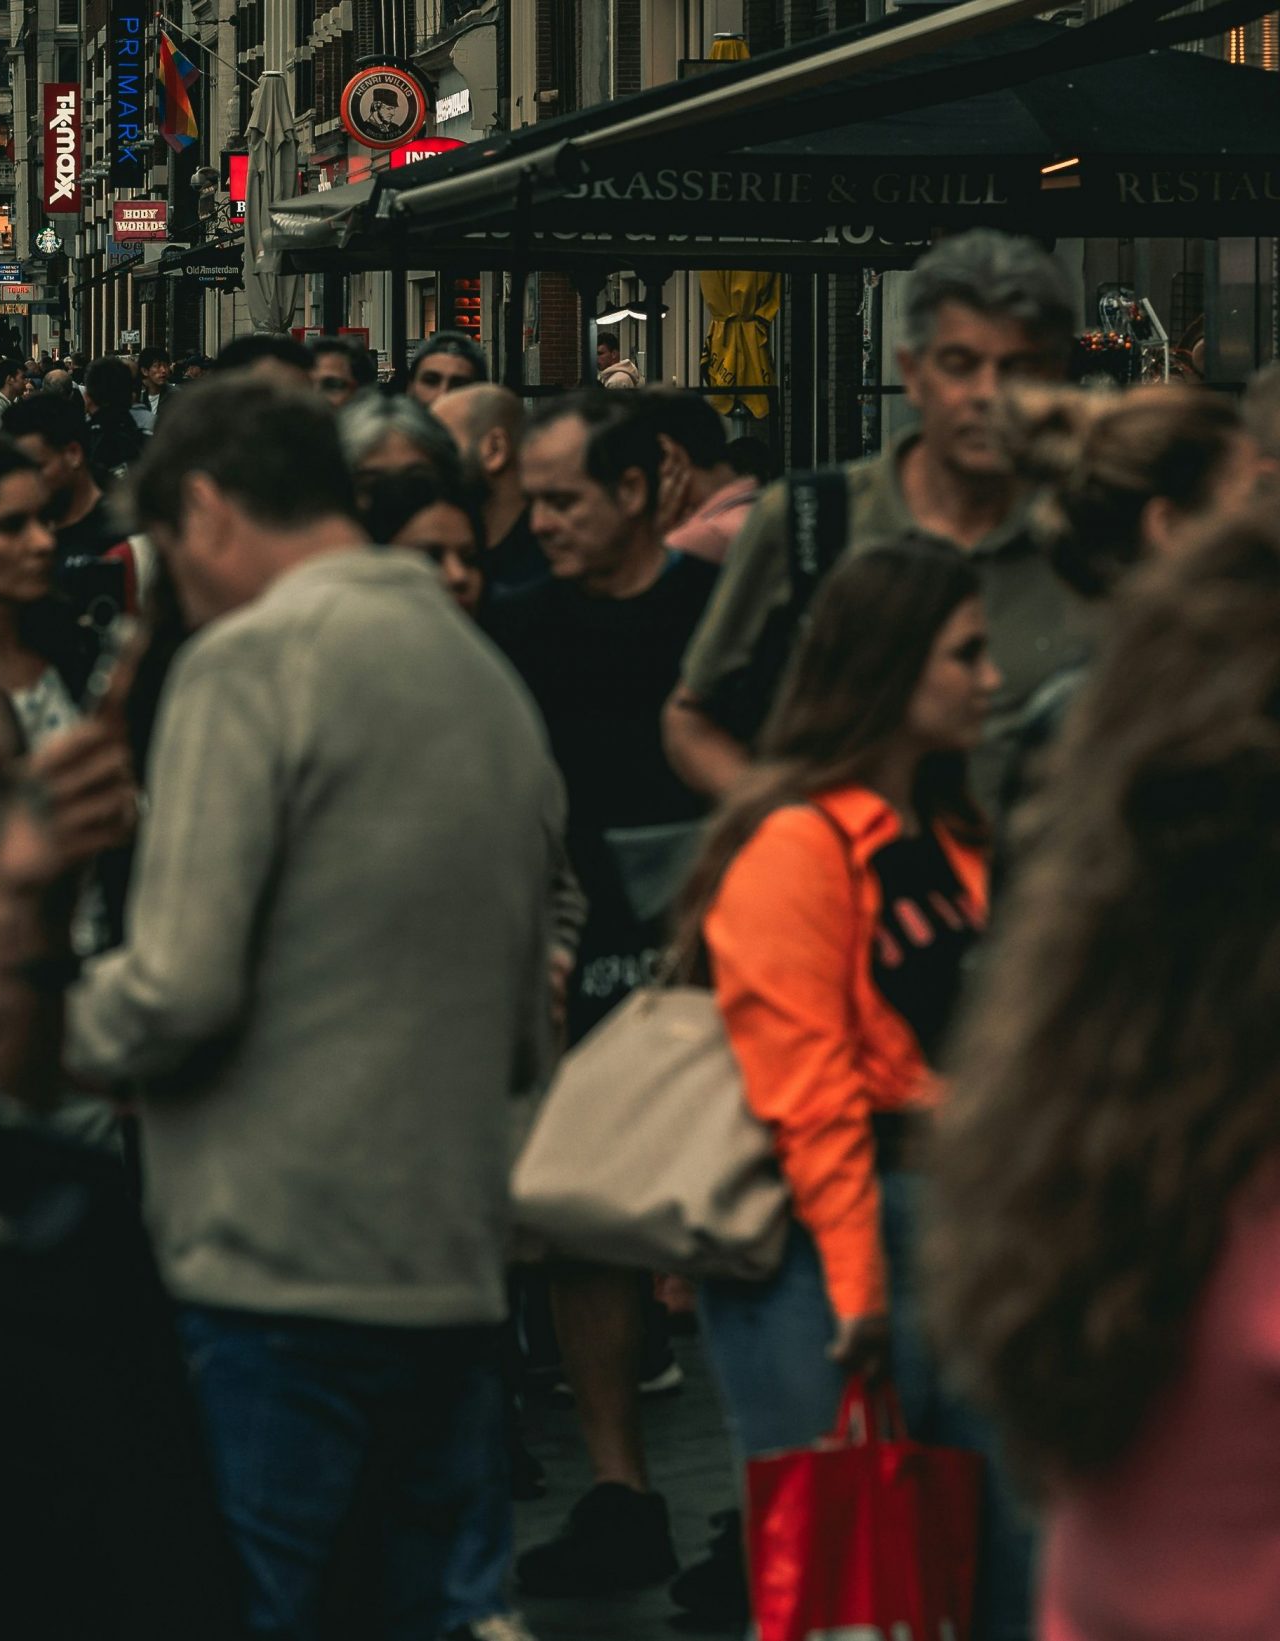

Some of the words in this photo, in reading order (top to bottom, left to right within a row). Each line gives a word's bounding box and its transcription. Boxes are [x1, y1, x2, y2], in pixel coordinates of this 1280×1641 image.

[117, 17, 140, 164] PRIMARK
[355, 76, 382, 97] HENRI
[384, 75, 413, 98] WILLIG
[827, 172, 857, 204] &
[873, 172, 1008, 205] GRILL
[122, 208, 158, 220] BODY
[115, 221, 167, 232] WORLDS
[186, 265, 200, 275] Old
[200, 265, 239, 274] Amsterdam
